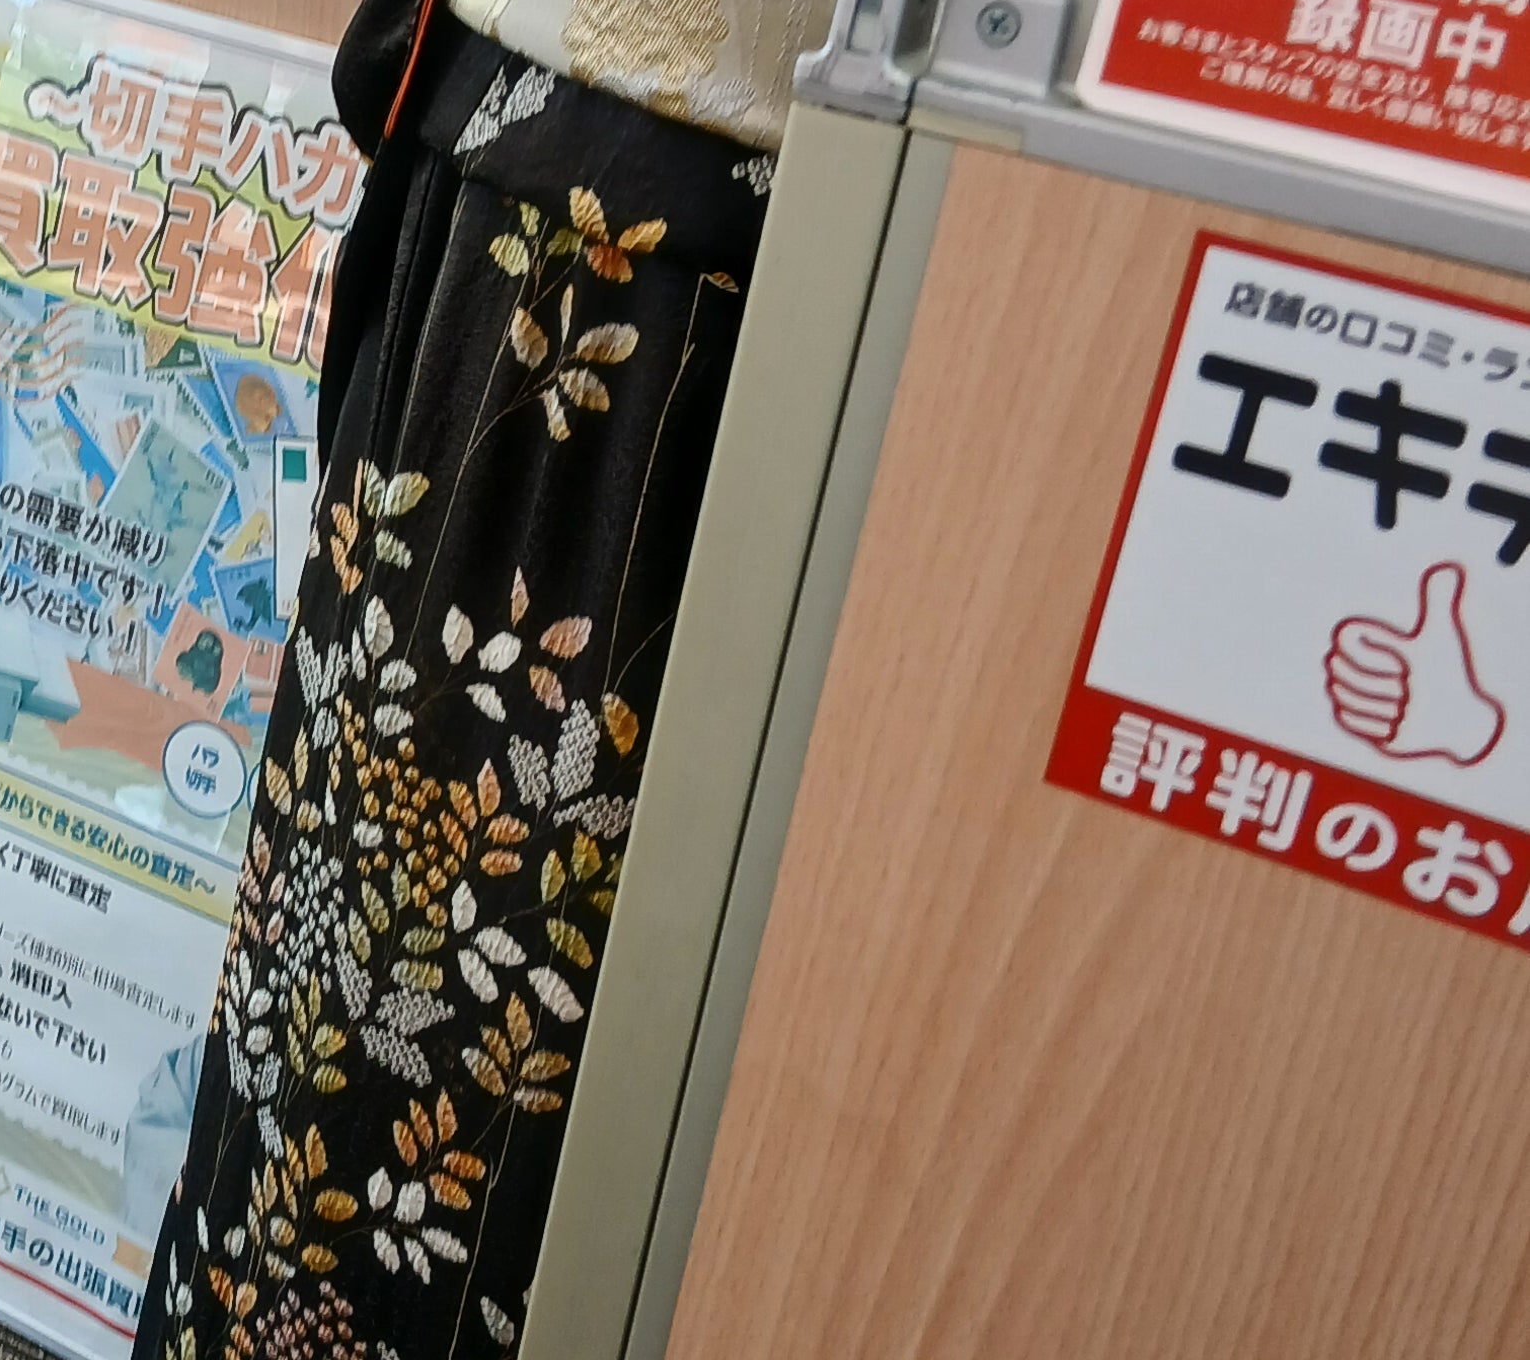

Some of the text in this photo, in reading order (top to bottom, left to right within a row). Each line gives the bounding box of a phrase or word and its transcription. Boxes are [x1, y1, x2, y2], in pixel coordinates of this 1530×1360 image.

[185, 766, 218, 795] 切手
[1099, 711, 1530, 938] 評判のお
[14, 1183, 106, 1245] THE GOLD
